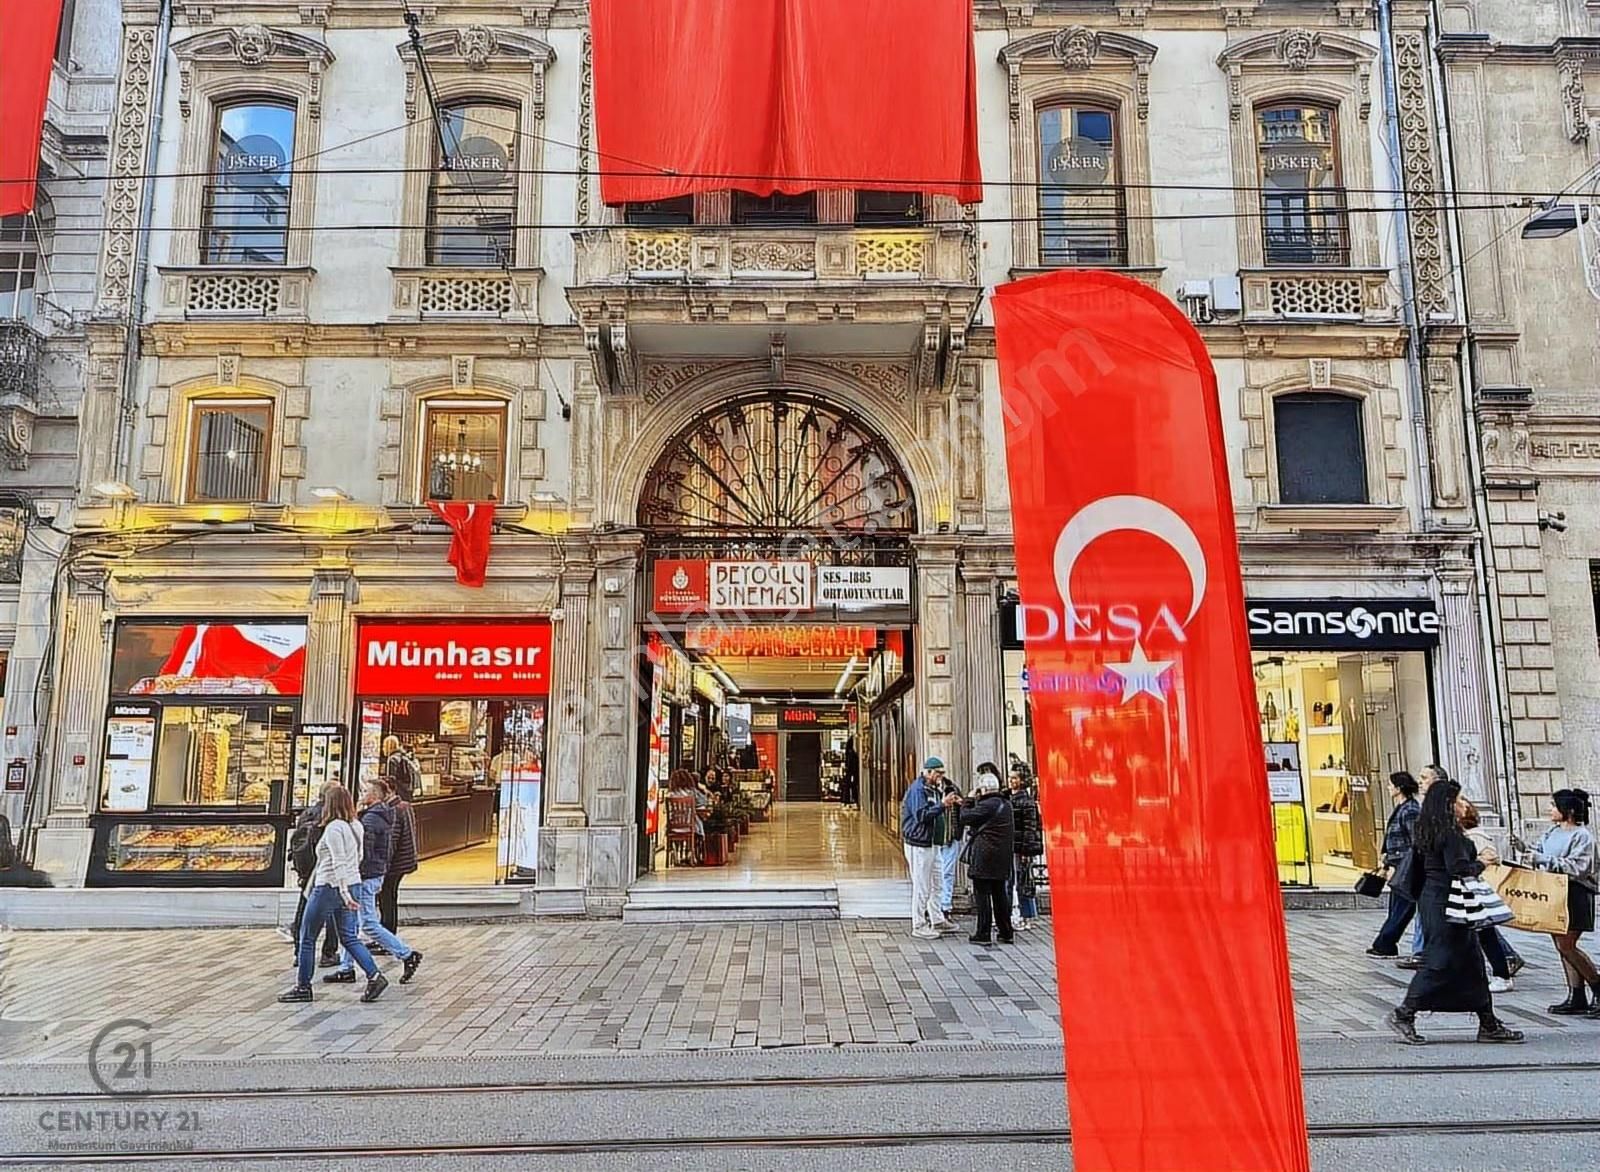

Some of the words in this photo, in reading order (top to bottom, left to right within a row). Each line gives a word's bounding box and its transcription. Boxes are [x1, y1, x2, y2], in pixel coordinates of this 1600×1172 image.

[716, 561, 805, 585] BEYOĞLU
[823, 587, 904, 600] ORTAOYUNCULAR
[1015, 603, 1187, 643] DESA
[1248, 607, 1439, 639] Samsonite
[367, 640, 541, 667] Münhasır
